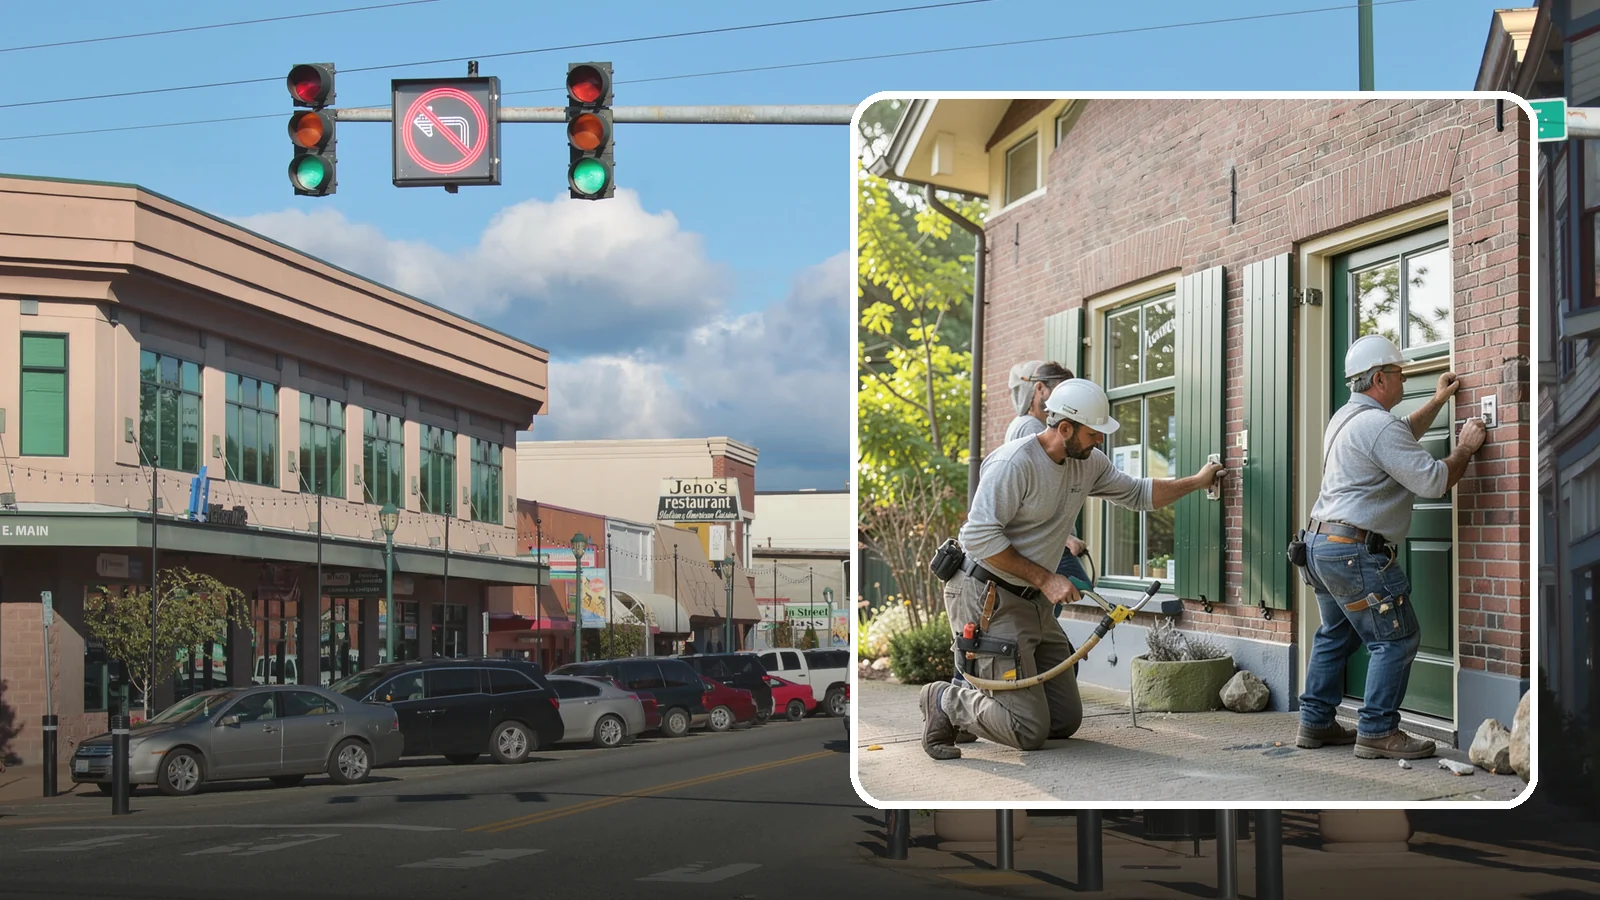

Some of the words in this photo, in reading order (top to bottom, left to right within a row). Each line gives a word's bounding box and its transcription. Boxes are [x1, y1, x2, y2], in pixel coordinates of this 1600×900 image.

[670, 480, 727, 494] Jeno's
[665, 496, 730, 508] restaurant
[659, 510, 681, 519] Italian
[686, 510, 714, 519] American
[715, 509, 736, 519] Cuisine
[2, 525, 13, 536] E.
[15, 525, 49, 536] MAIN
[786, 607, 794, 616] in
[797, 608, 828, 616] Street
